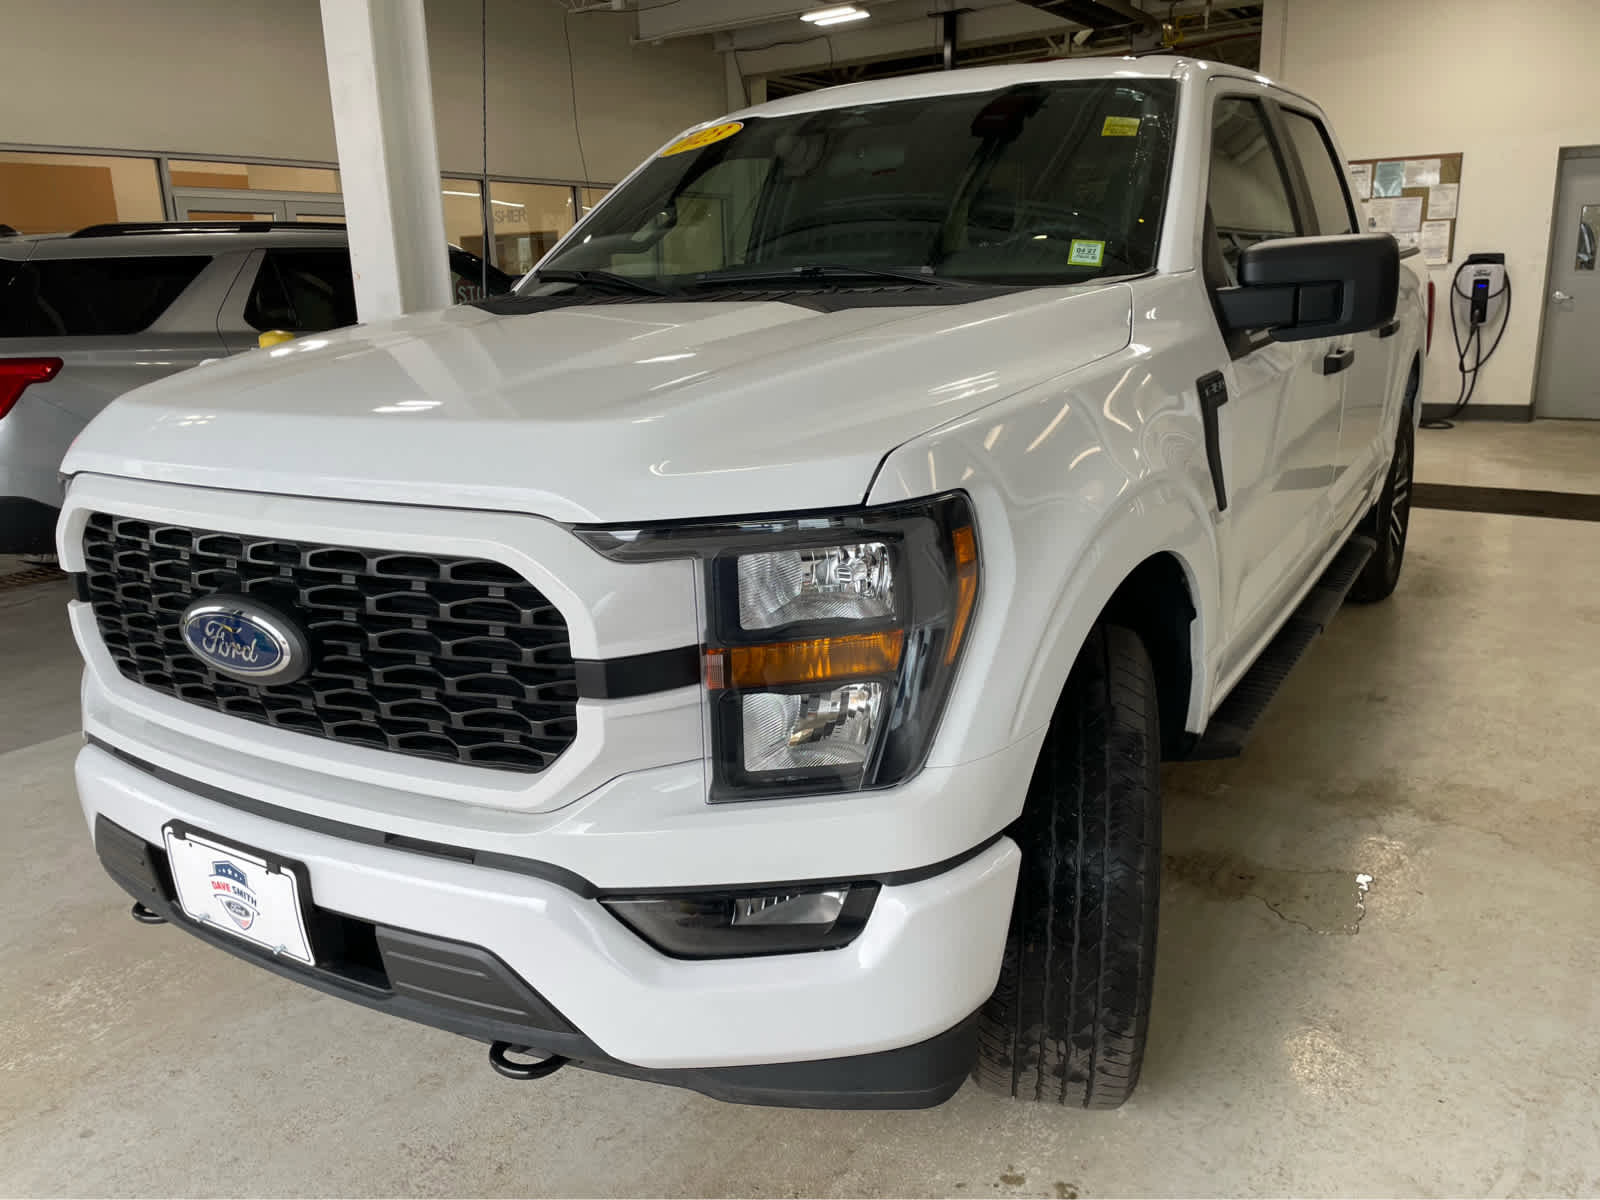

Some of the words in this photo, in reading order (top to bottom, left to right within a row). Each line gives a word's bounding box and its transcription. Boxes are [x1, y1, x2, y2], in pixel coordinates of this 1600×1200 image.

[202, 620, 259, 664] Ford
[210, 880, 231, 893] DAVE
[232, 885, 257, 907] SMITH
